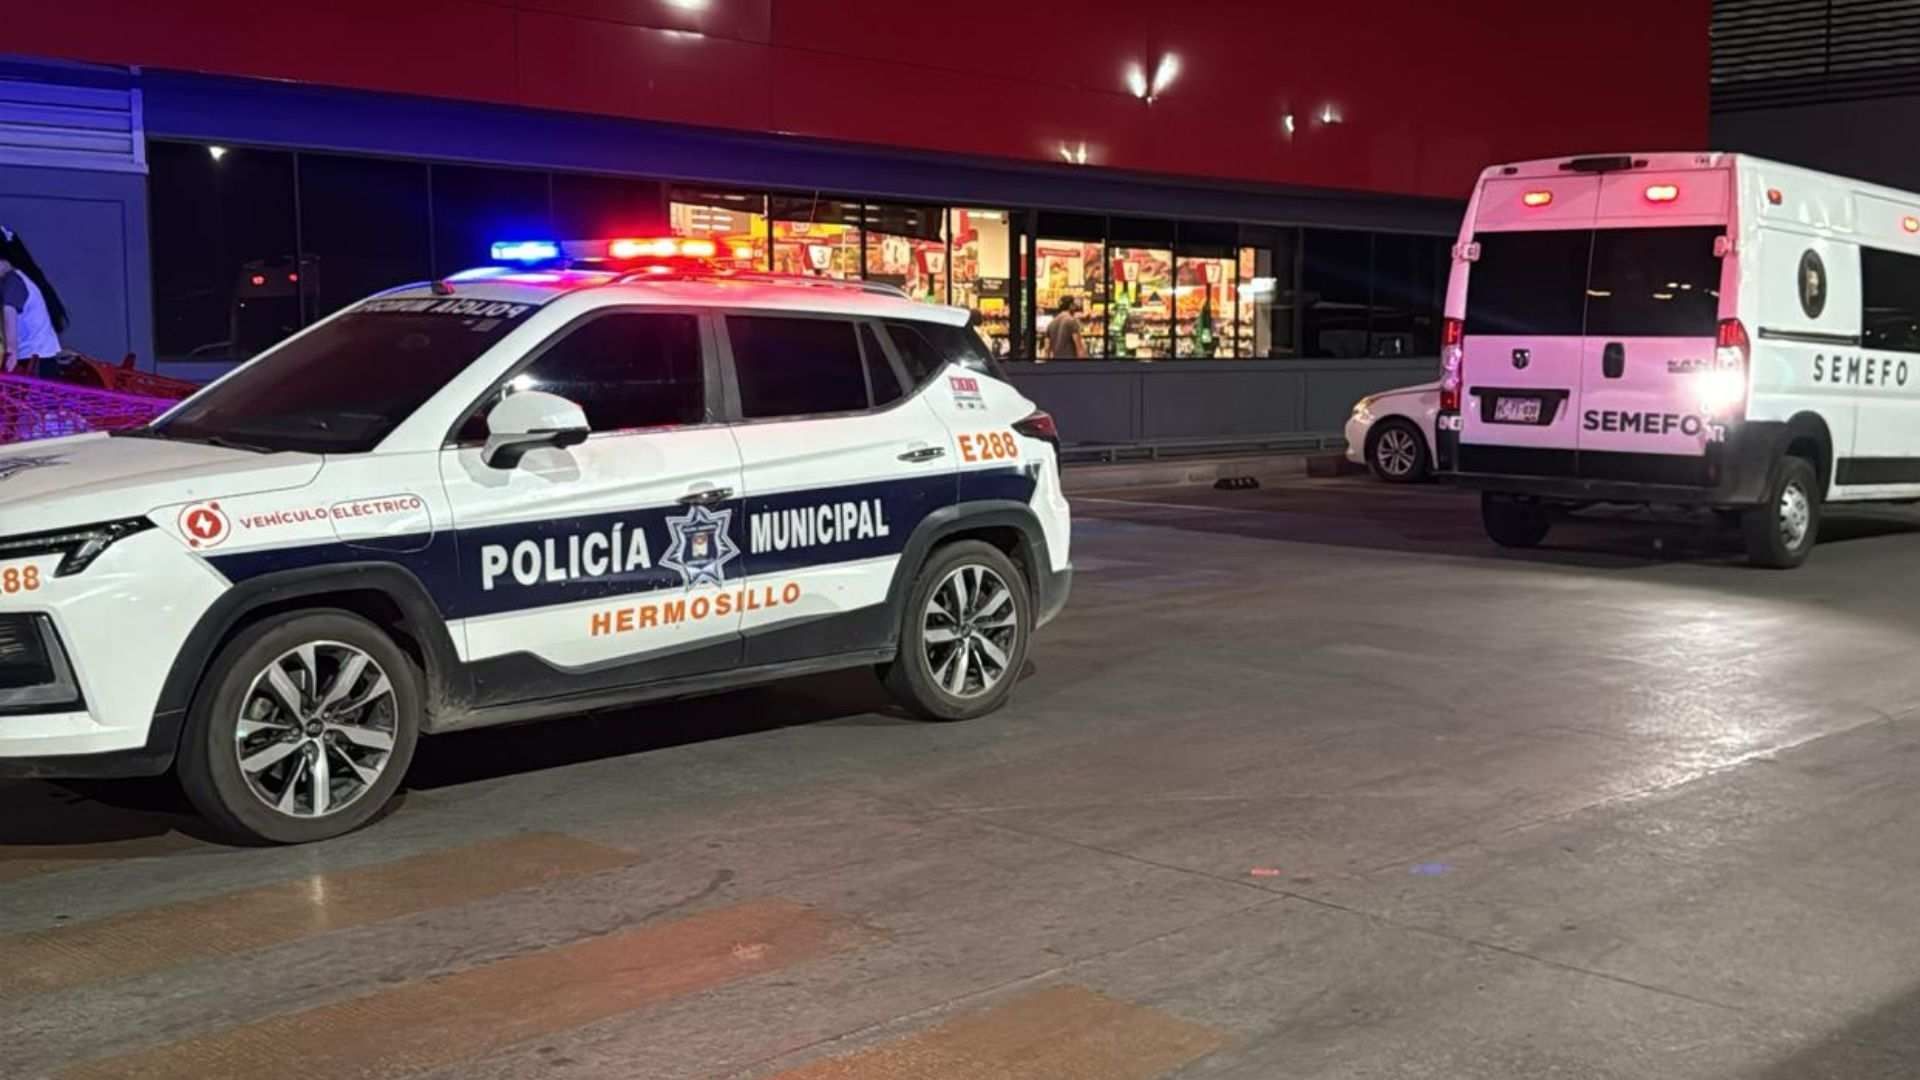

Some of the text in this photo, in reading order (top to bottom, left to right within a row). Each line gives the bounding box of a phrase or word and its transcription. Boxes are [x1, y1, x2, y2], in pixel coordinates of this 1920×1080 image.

[1813, 353, 1908, 387] SEMEFO
[1583, 409, 1702, 437] SEMEFO
[240, 497, 421, 528] VEHÍCULO ELÉCTRICO
[481, 498, 889, 590] POLICÍA MUNICIPAL
[0, 565, 40, 594] 88
[590, 582, 801, 637] HERMOSILLO
